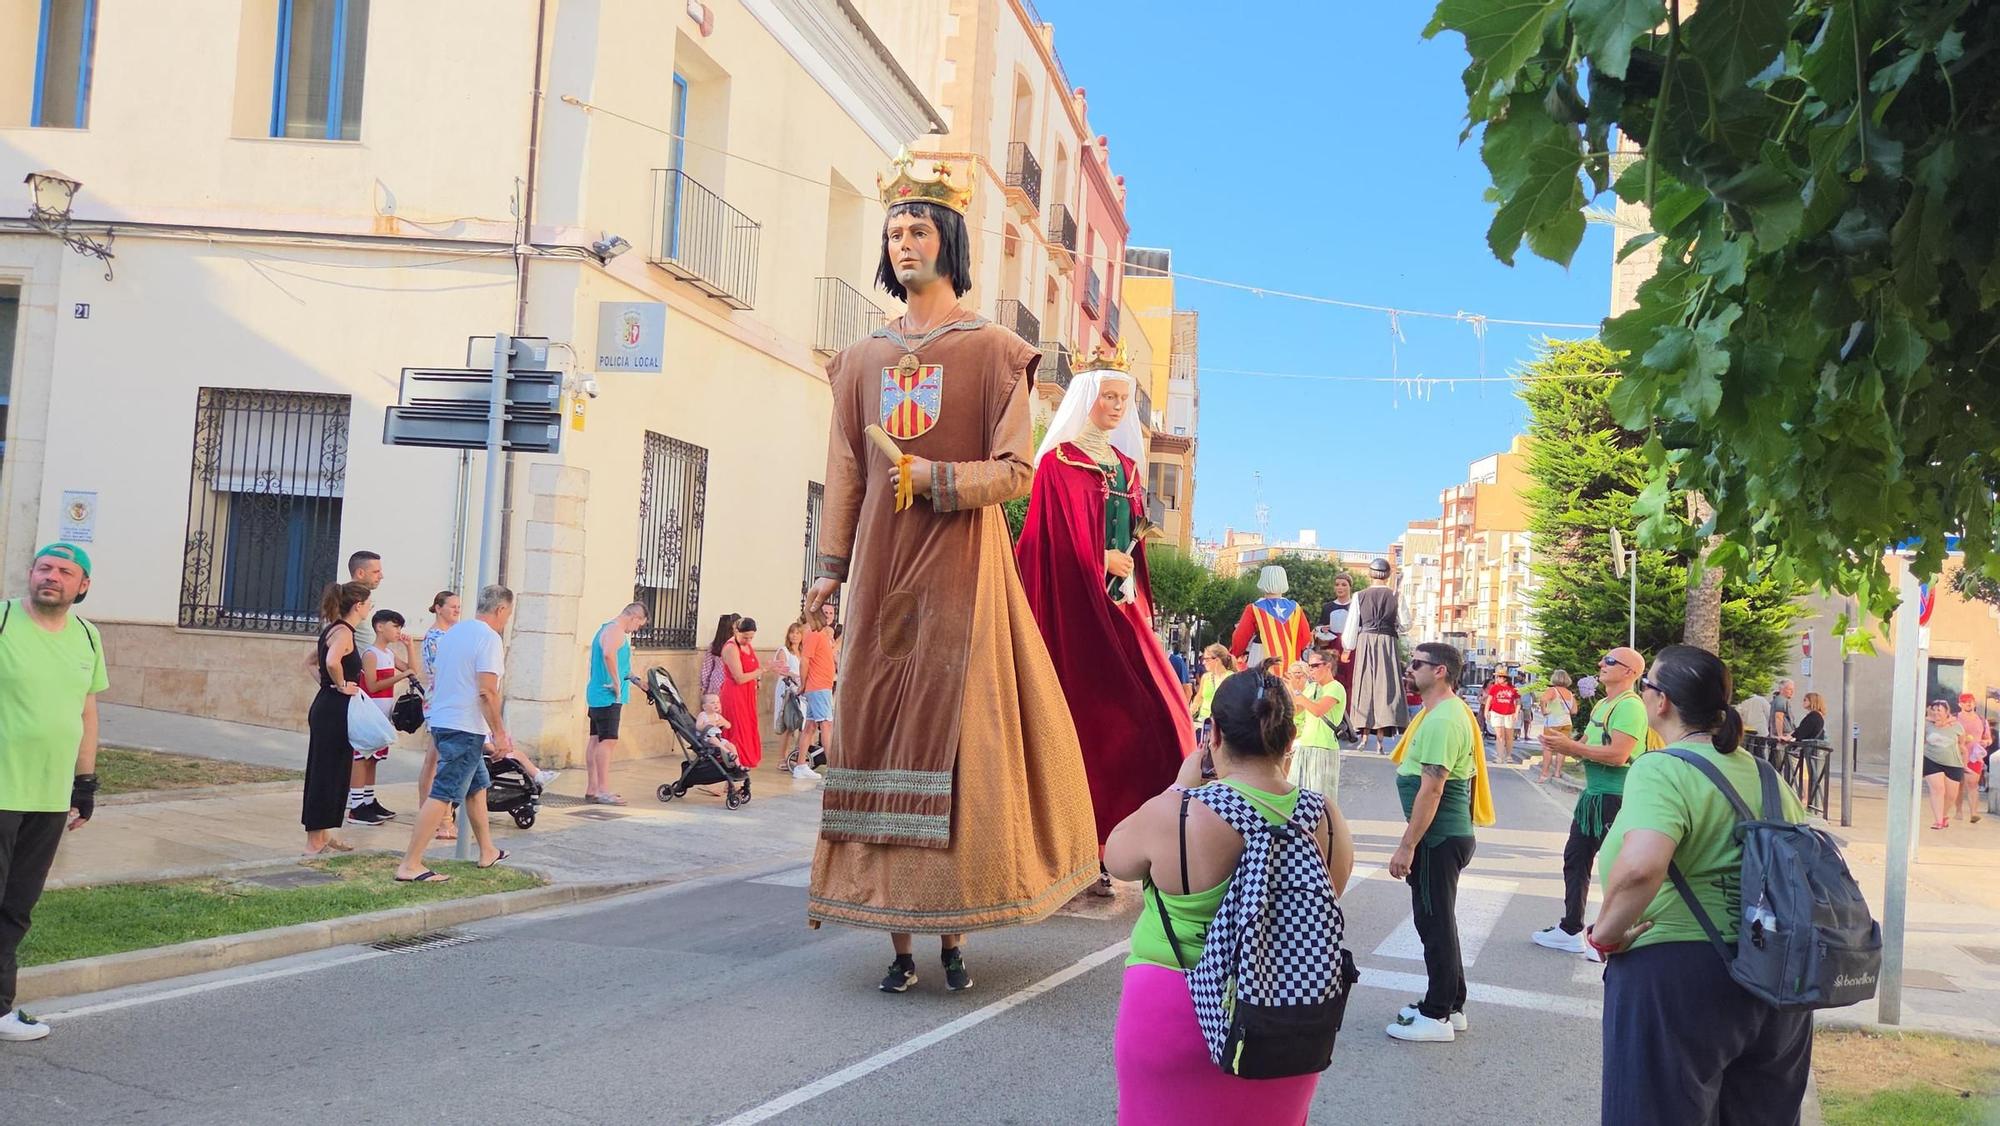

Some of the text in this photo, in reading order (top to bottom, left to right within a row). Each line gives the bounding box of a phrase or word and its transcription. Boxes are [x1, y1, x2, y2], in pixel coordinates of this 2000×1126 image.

[76, 305, 89, 318] 21
[599, 356, 659, 368] POLICIA LOCAL
